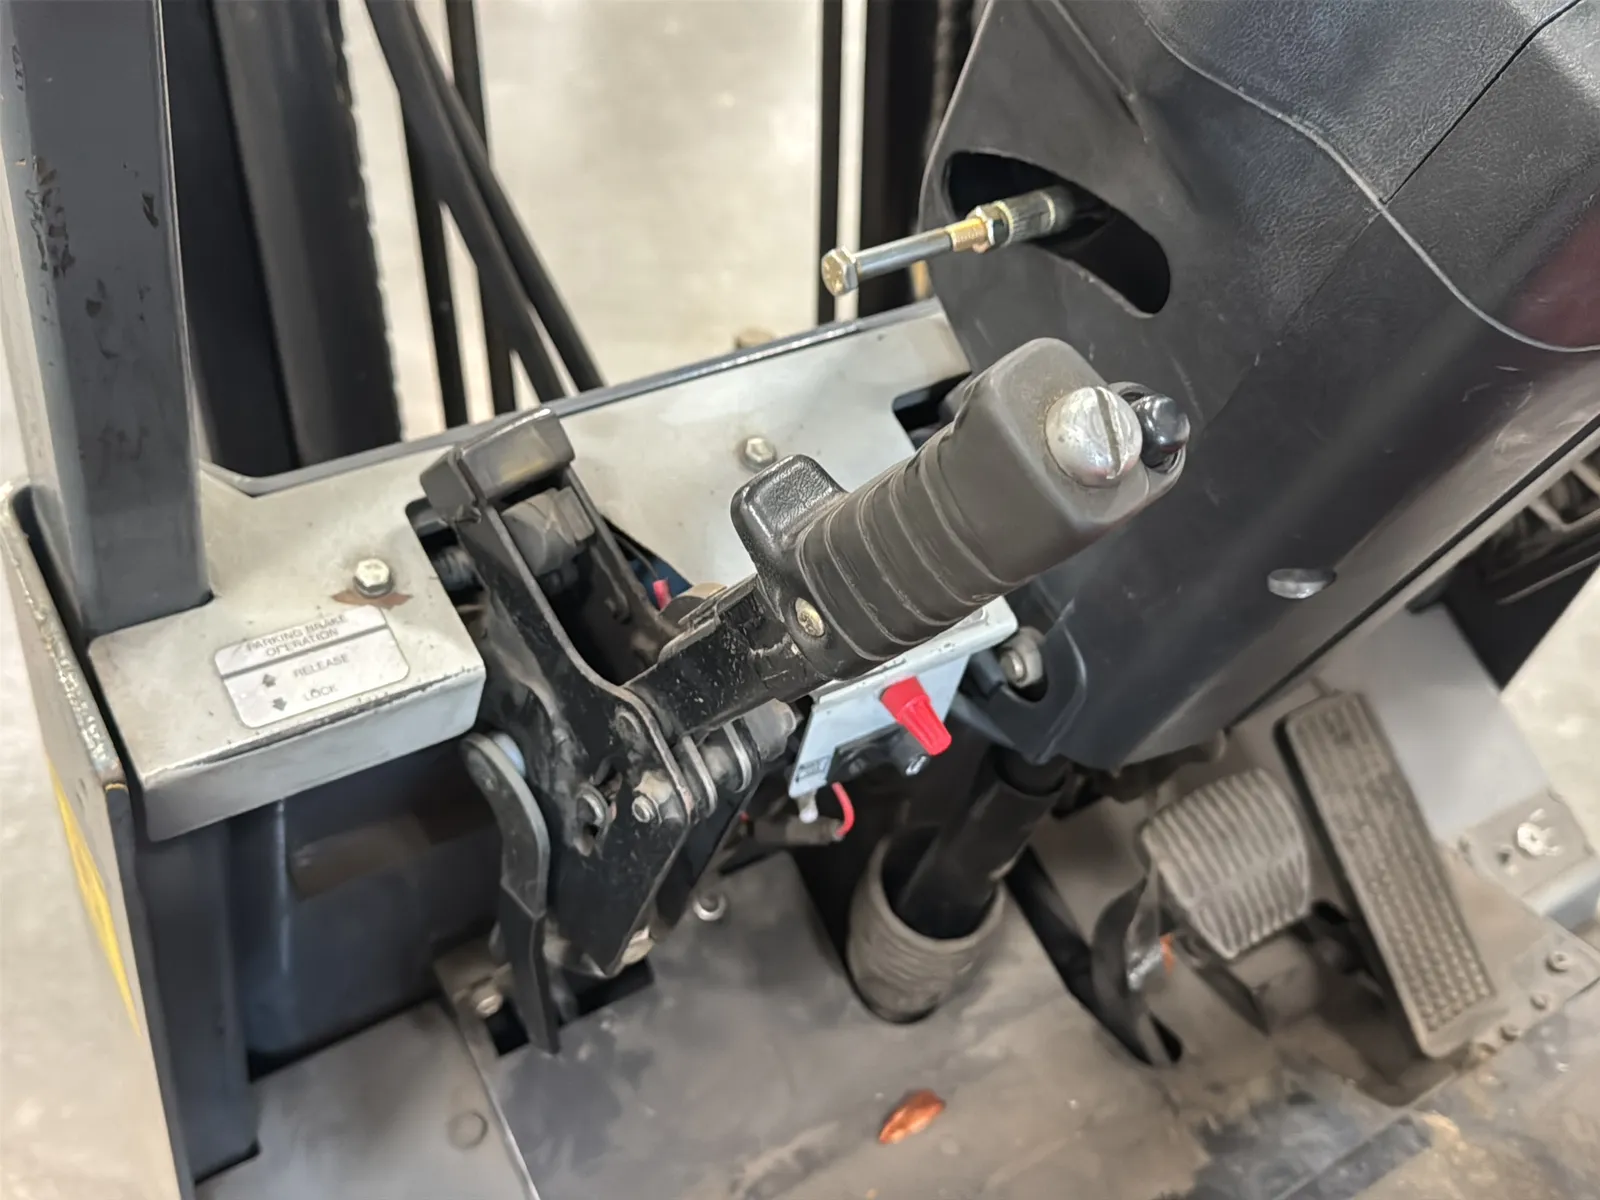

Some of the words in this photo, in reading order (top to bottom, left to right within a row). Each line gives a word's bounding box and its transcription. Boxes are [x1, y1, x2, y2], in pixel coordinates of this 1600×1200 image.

[247, 629, 302, 651] PARKING
[305, 614, 347, 634] BRAKE
[265, 628, 339, 656] OPERATION
[293, 653, 350, 678] RELEASE
[303, 684, 338, 702] LOCK
